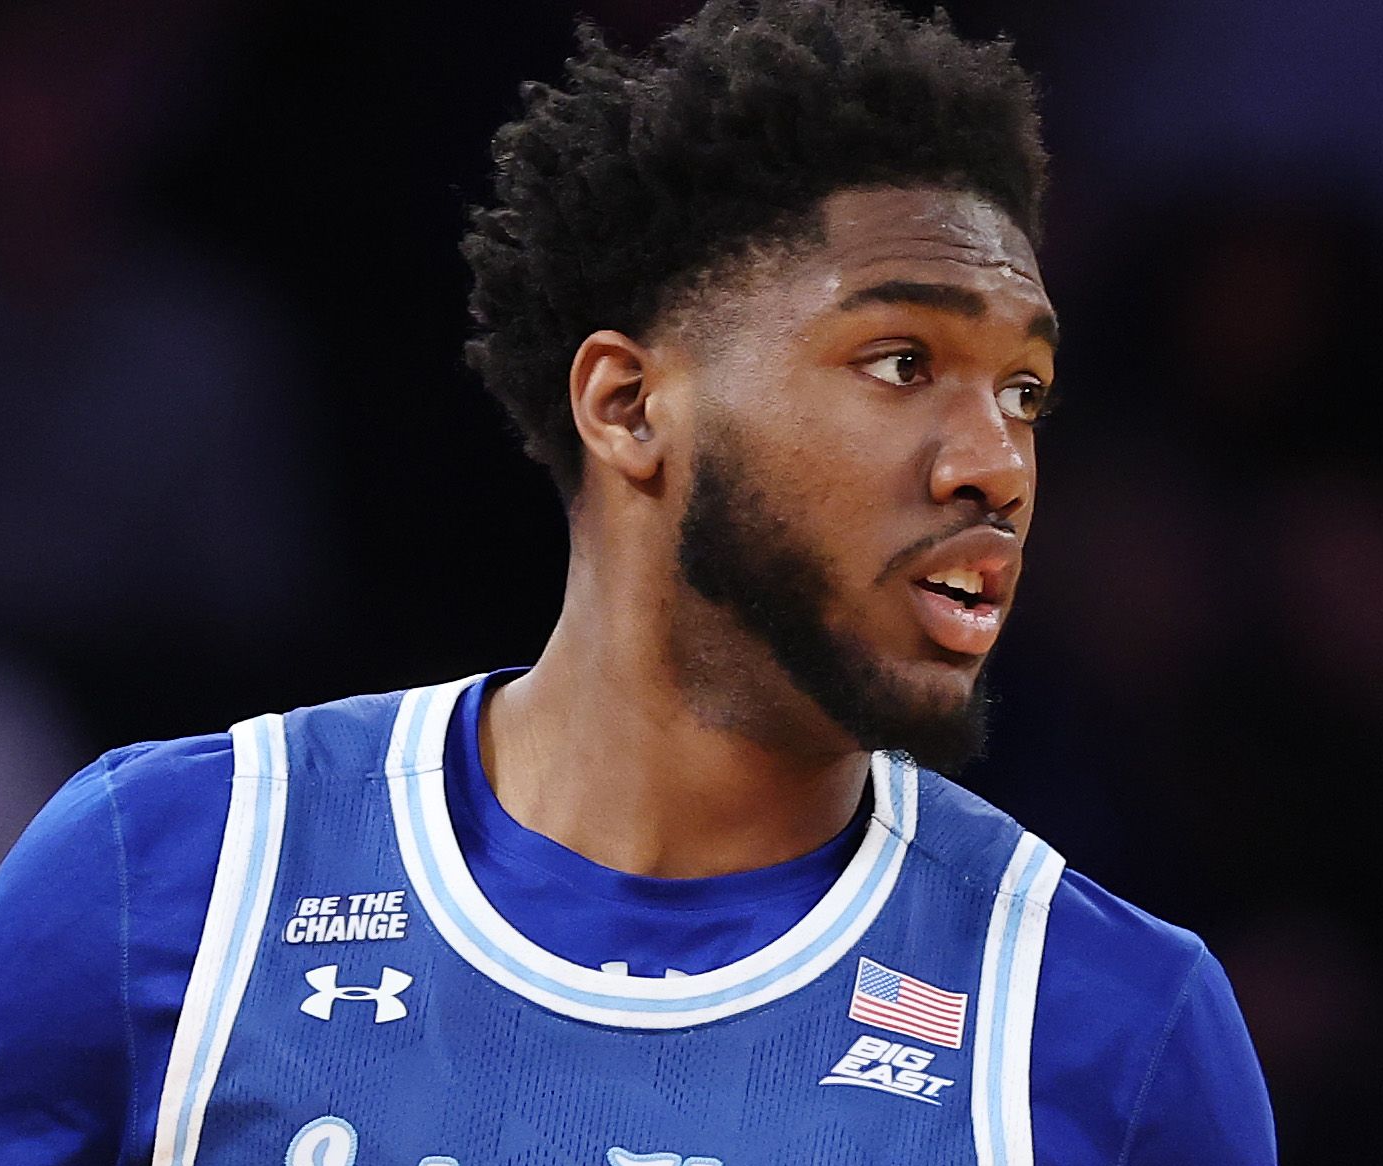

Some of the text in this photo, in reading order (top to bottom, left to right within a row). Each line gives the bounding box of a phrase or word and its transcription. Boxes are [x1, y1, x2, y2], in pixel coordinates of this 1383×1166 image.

[297, 890, 406, 917] BE THE
[284, 913, 408, 944] CHANGE
[848, 1034, 937, 1072] BIG
[830, 1054, 955, 1098] EAST
